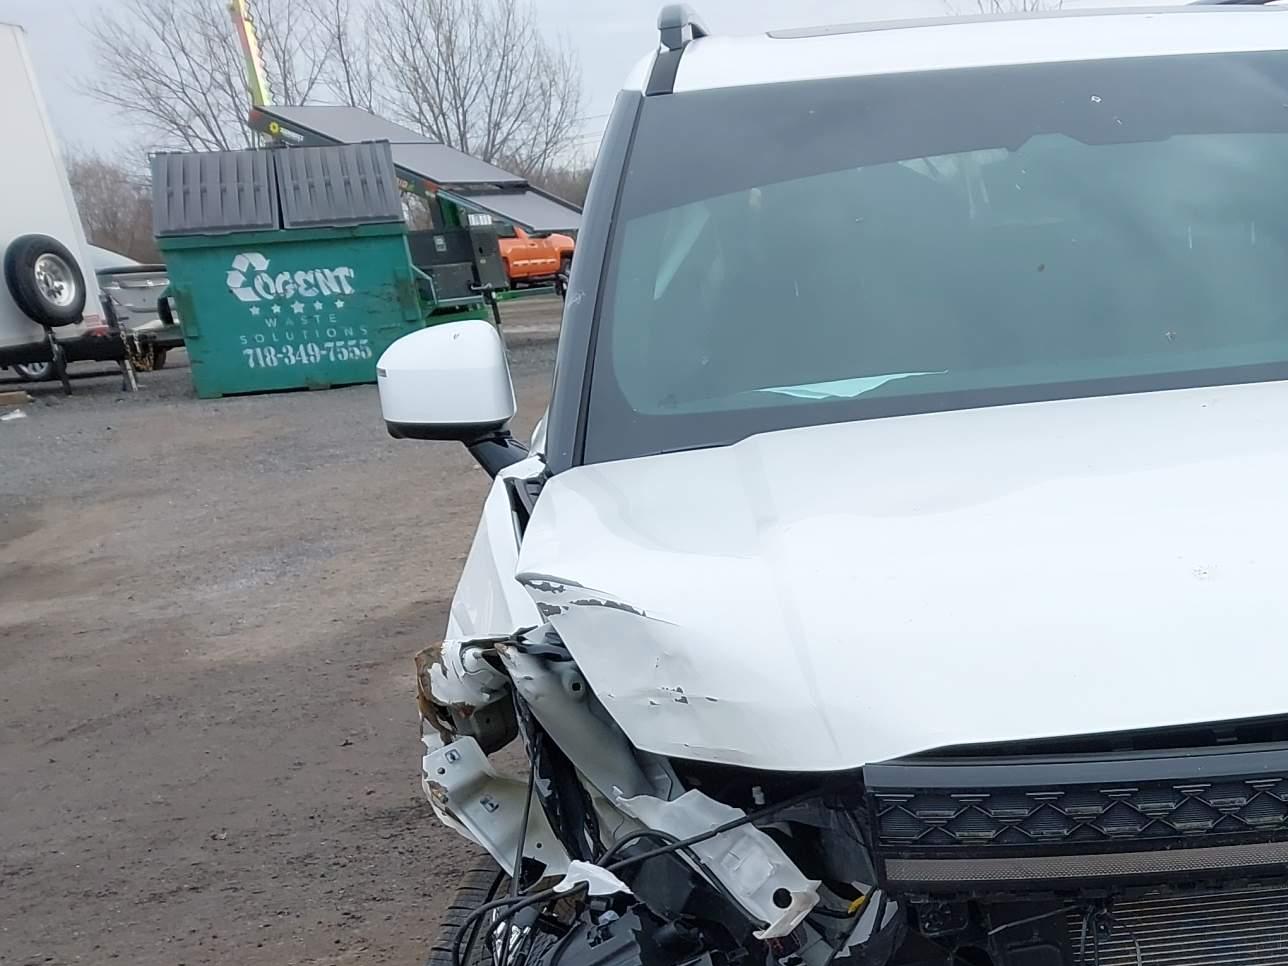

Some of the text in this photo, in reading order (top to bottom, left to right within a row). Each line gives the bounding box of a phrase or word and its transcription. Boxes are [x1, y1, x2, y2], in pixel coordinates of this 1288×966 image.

[265, 314, 337, 328] WASTE
[240, 325, 368, 344] SOLUTIONS
[243, 339, 372, 368] 718-349-7555
